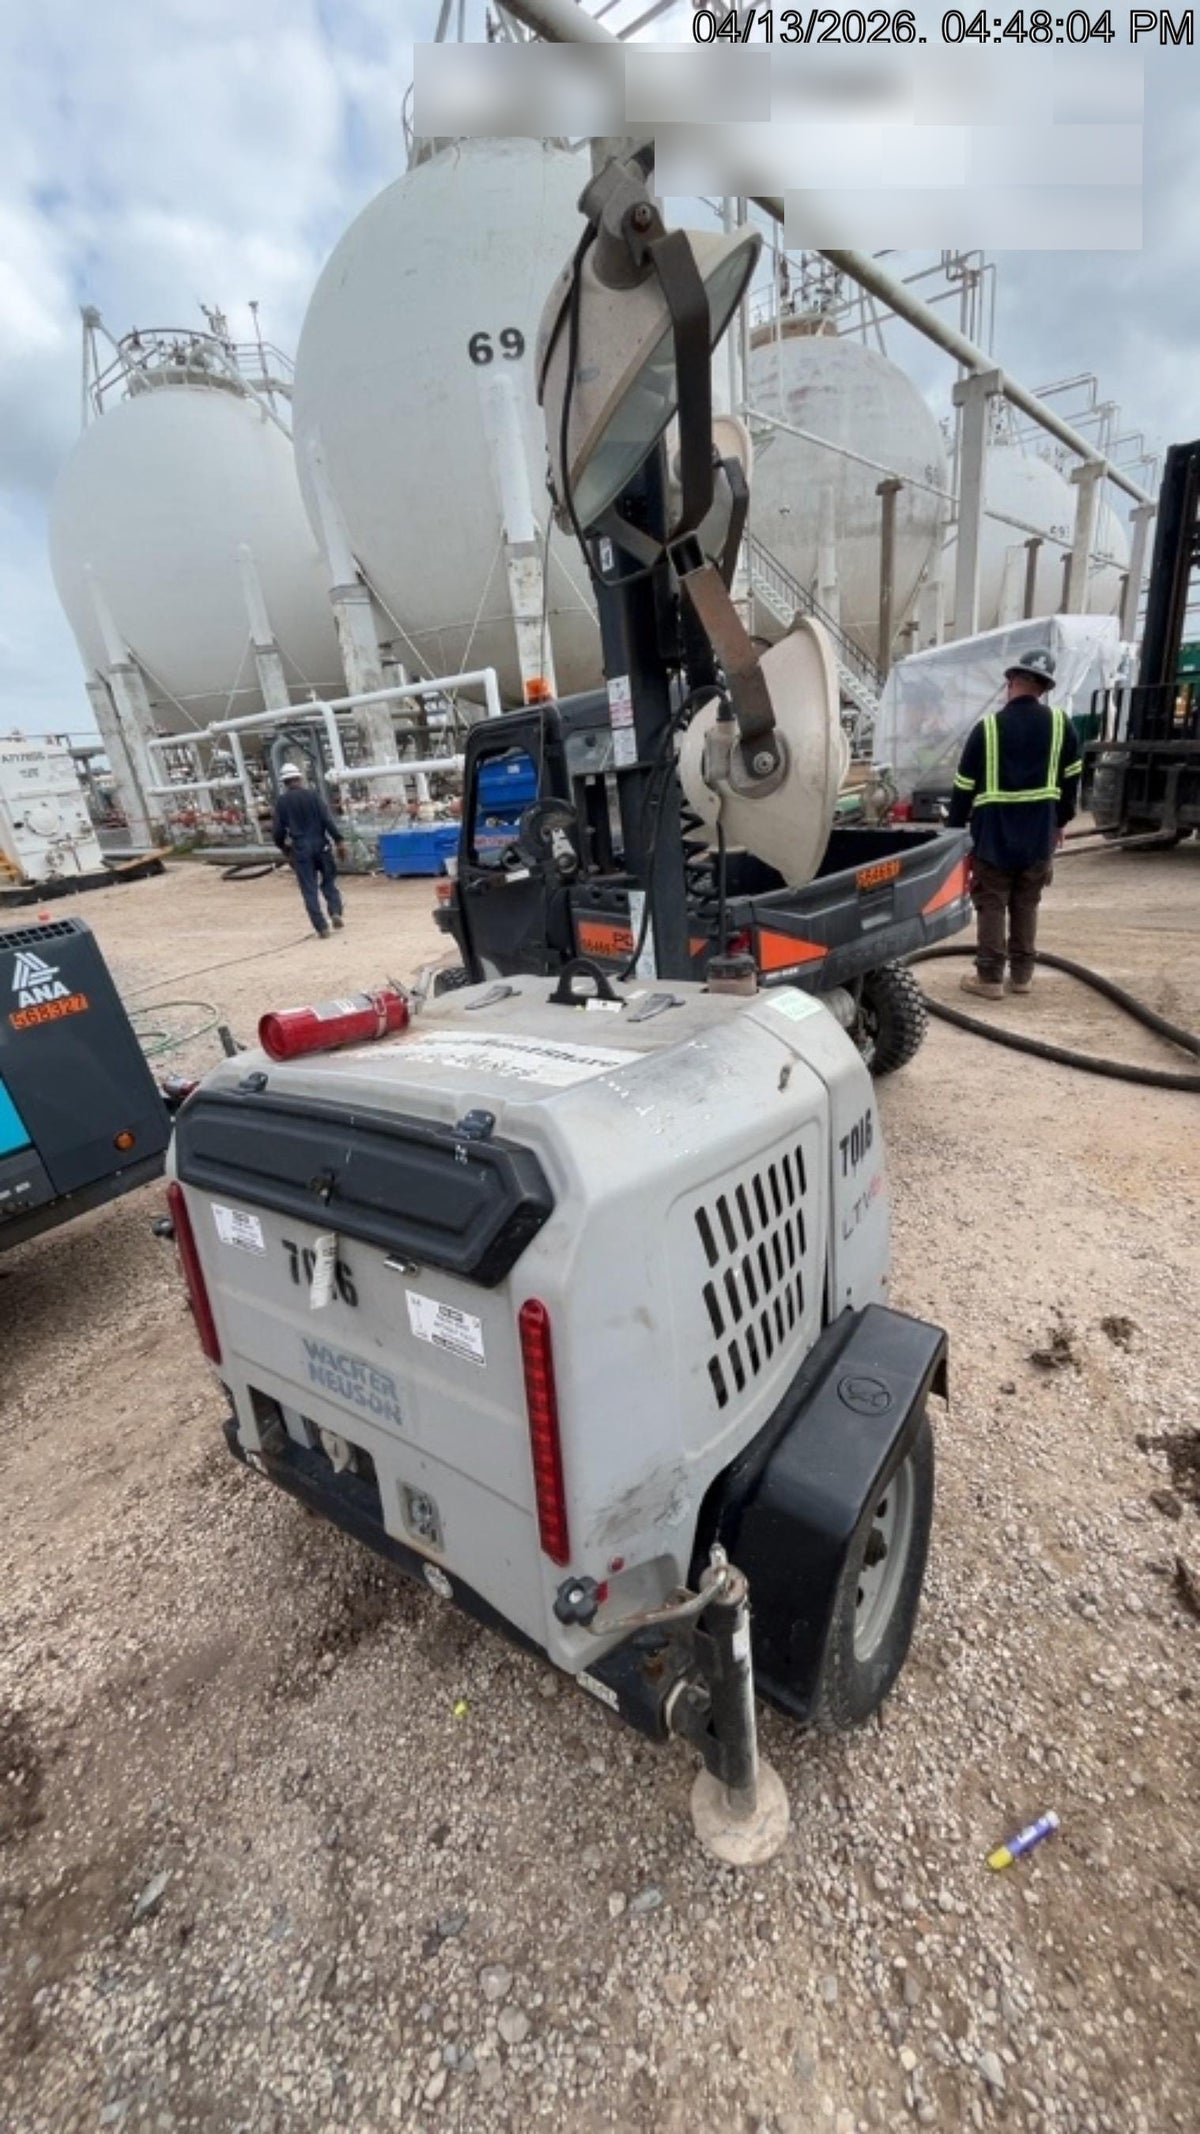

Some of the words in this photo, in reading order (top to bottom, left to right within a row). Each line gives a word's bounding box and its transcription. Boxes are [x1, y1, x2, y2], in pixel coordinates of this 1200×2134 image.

[468, 326, 525, 367] 69
[18, 980, 72, 1008] ANA
[308, 1361, 402, 1426] NEUSON
